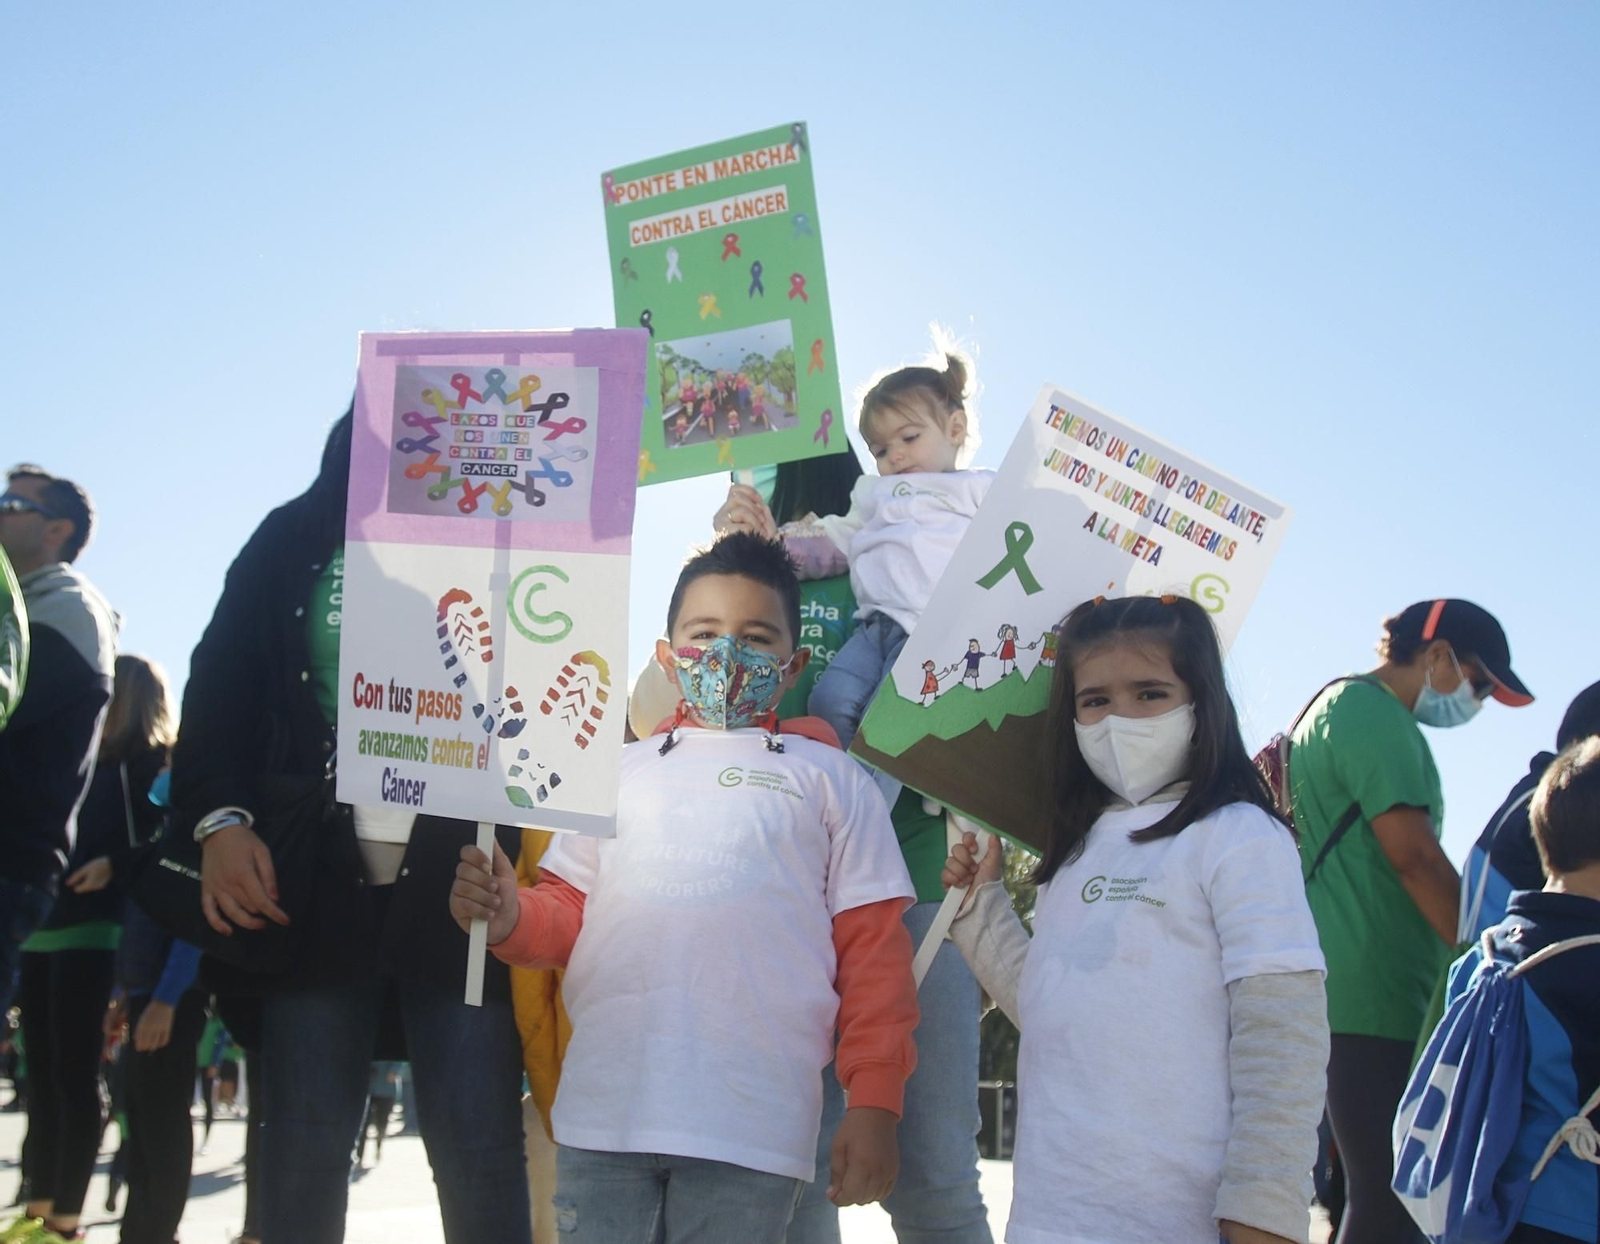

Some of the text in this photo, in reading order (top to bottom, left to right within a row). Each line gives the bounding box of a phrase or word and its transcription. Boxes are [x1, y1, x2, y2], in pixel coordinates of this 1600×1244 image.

[614, 142, 798, 204] PONTE EN MARCHA
[631, 192, 787, 244] CONTRA EL CÁNCER
[451, 413, 536, 429] LAZOS QUE
[455, 430, 530, 446] NOS UNEN
[450, 446, 533, 462] CONTRA EL
[1045, 404, 1266, 543] TENEMOS UN CAMINO POR DELANTE,
[1044, 448, 1238, 562] JUNTOS Y JUNTAS LLEGAREMOS
[1083, 511, 1164, 567] A LA META
[353, 672, 463, 725] Con tus pasos
[358, 728, 491, 771] avanzamos contra el
[381, 766, 427, 807] Cáncer
[747, 781, 771, 790] contra
[1134, 893, 1166, 908] cáncer
